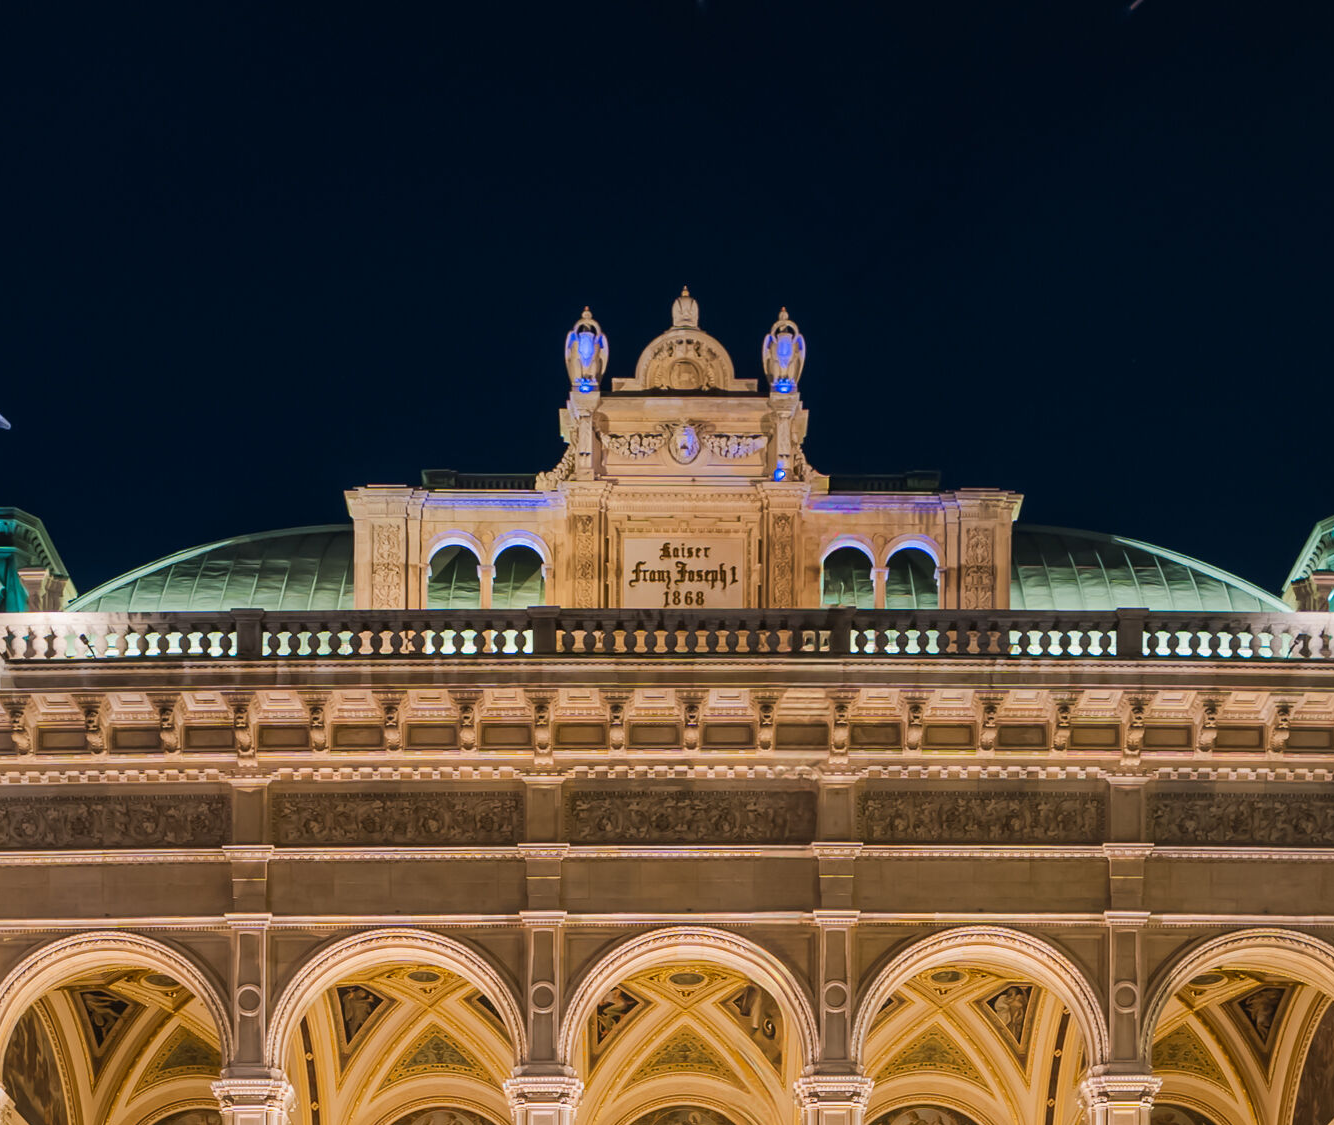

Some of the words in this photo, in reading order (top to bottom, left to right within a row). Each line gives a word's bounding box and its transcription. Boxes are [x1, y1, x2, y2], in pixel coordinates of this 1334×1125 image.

[659, 542, 711, 560] Kaiser
[629, 561, 672, 590] Franz
[674, 560, 727, 590] Joseph
[663, 591, 705, 607] 1868
